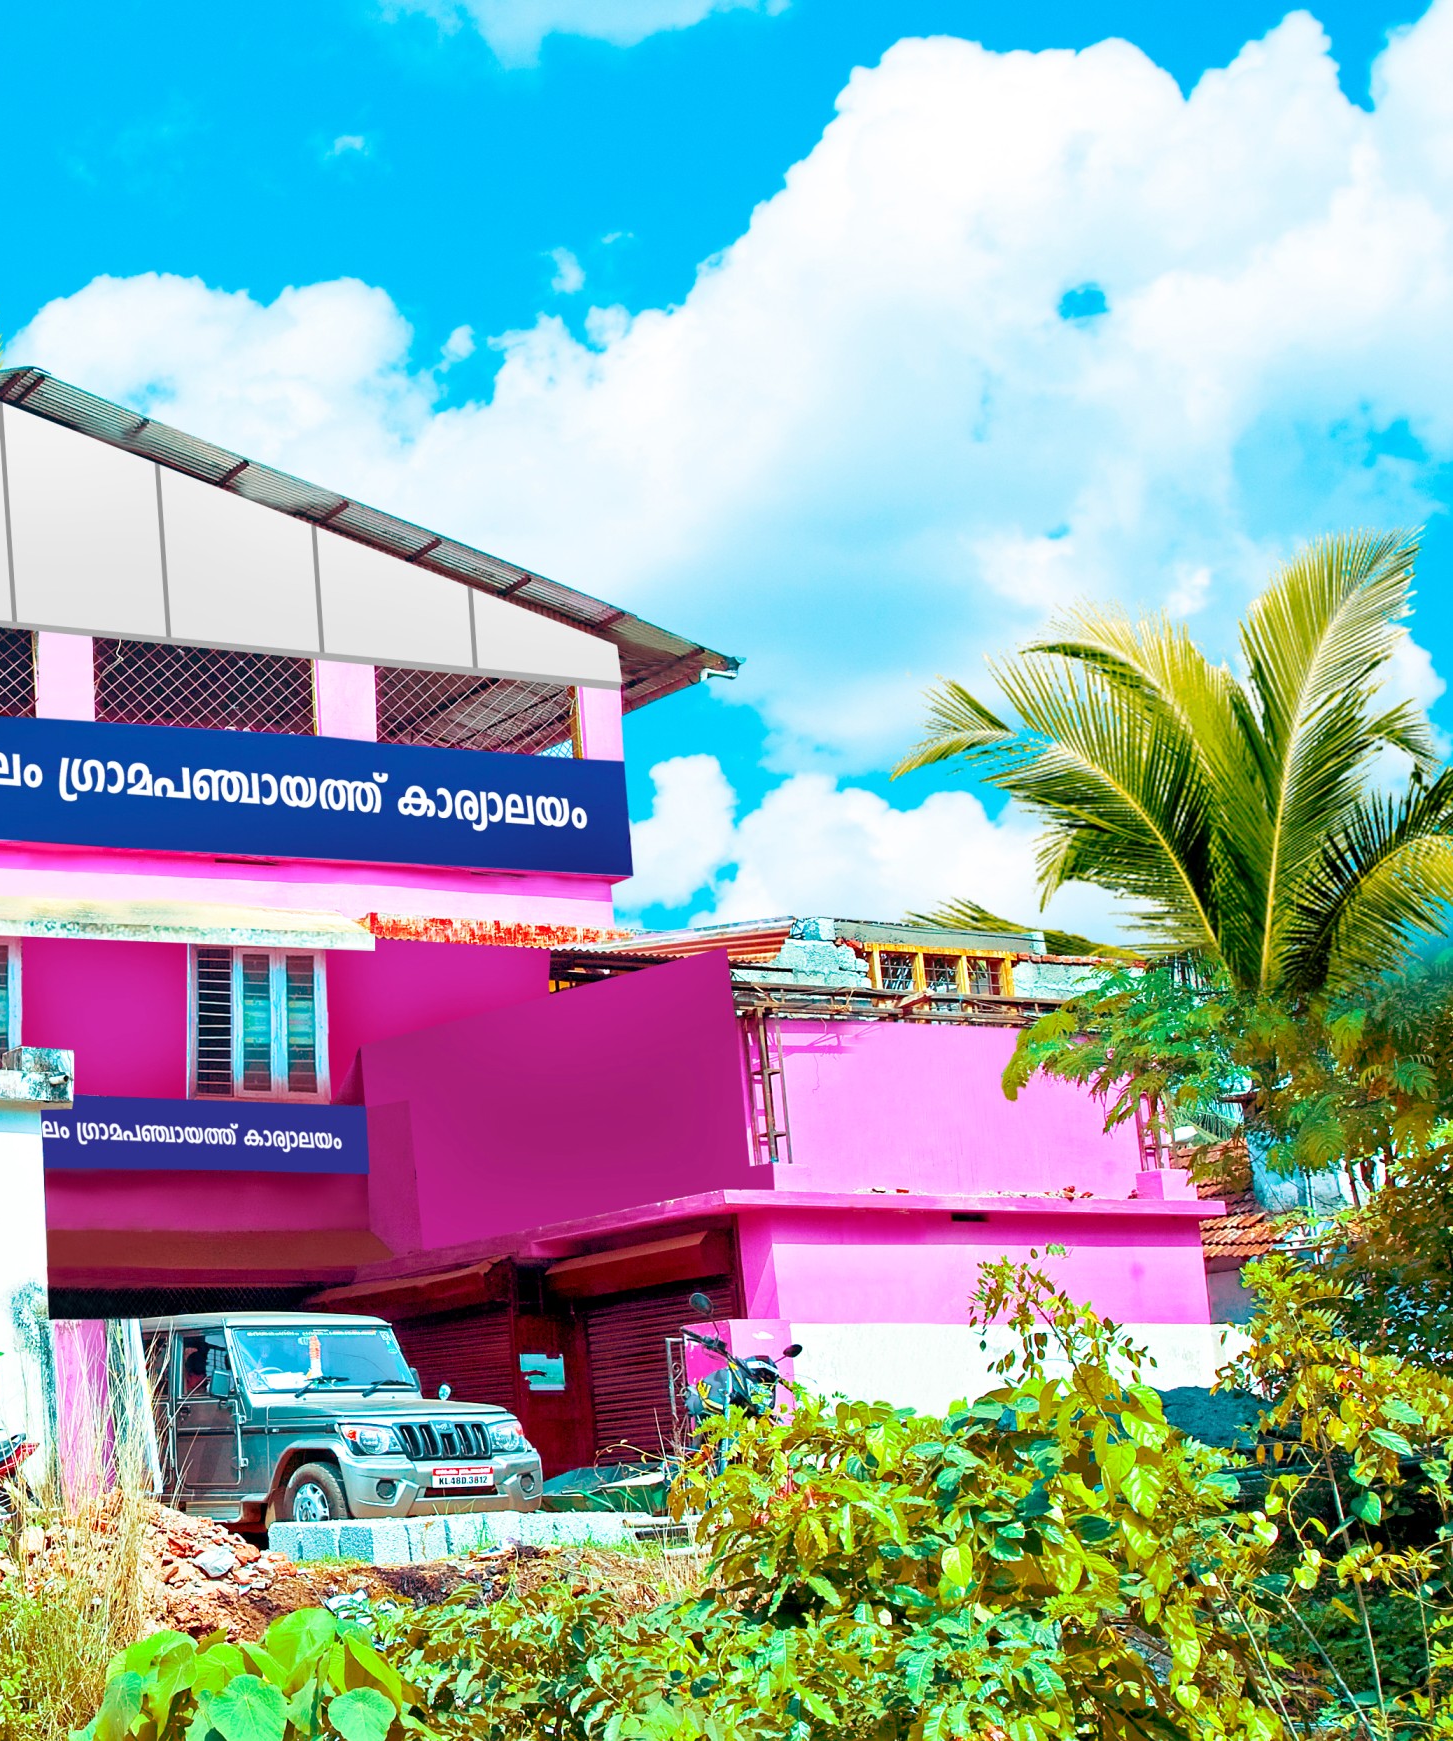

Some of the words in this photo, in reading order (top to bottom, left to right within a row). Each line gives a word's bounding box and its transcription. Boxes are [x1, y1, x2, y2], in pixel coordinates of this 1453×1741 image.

[58, 757, 389, 814] ഗ്രാമപഞ്ചായത്ത്
[397, 785, 588, 832] കാര്യാലയം
[76, 1122, 239, 1145] ഗ്രാമപഞ്ചായത്ത്
[243, 1129, 343, 1153] കാര്യാലയം
